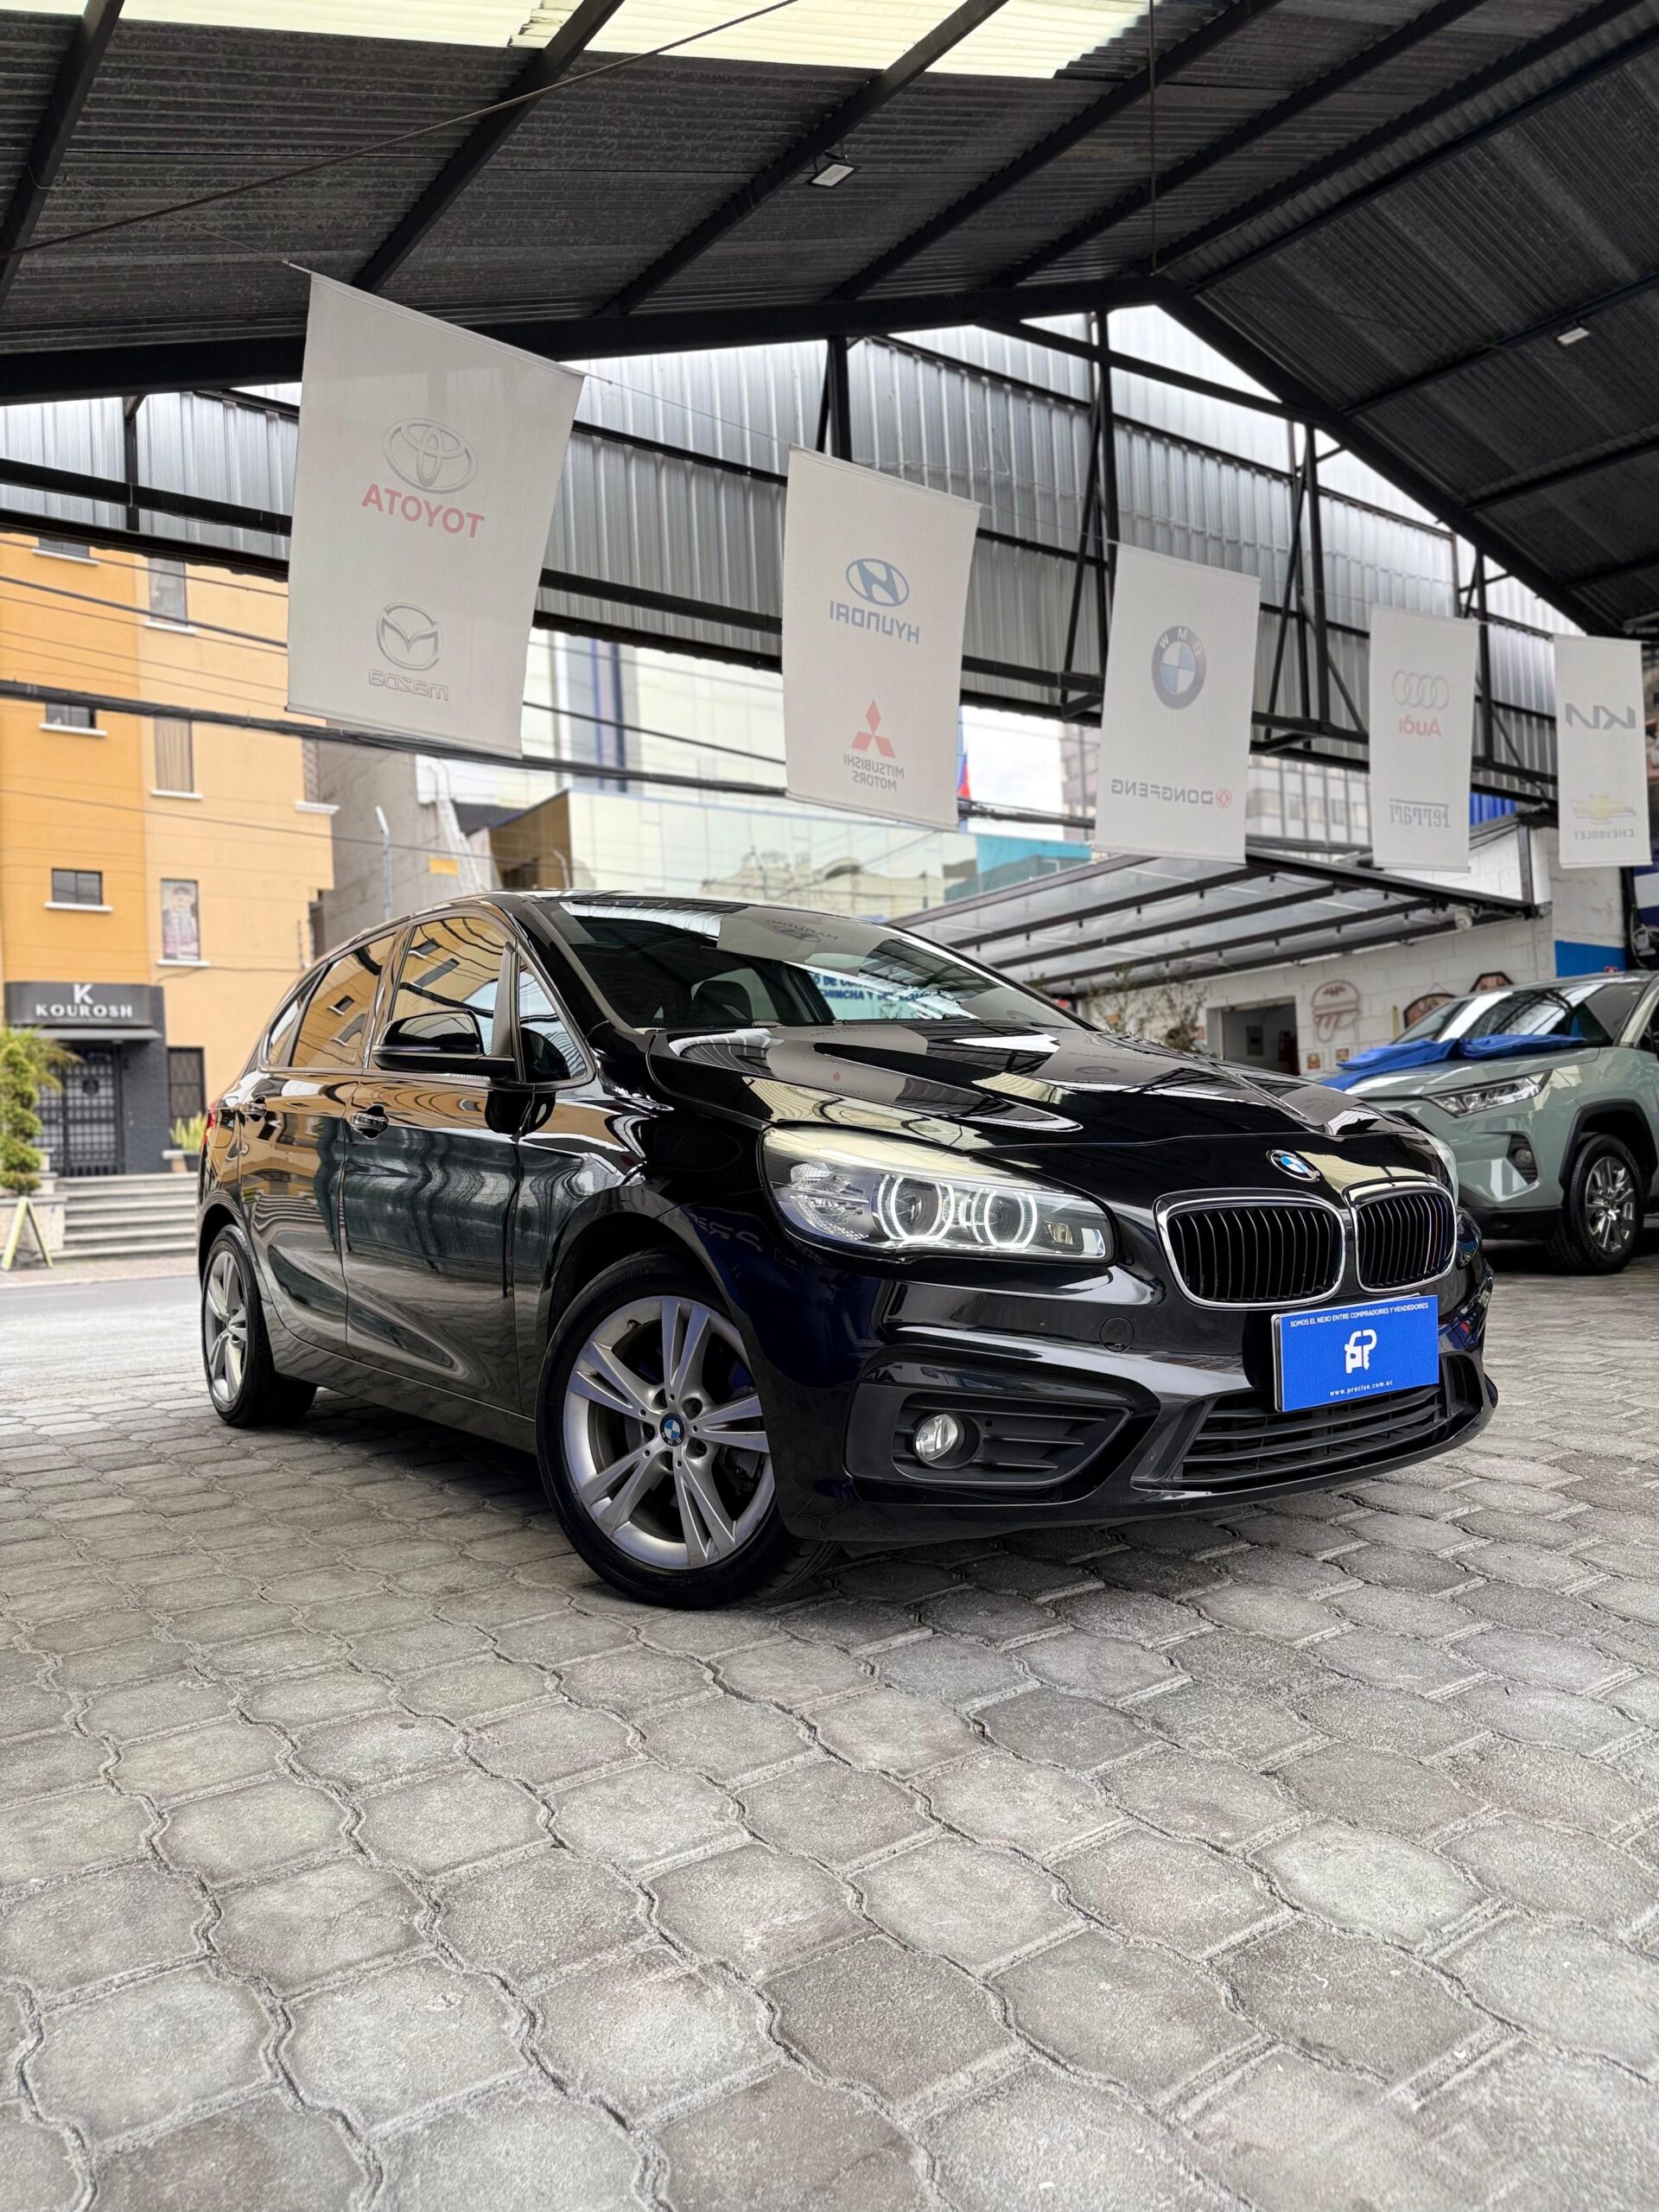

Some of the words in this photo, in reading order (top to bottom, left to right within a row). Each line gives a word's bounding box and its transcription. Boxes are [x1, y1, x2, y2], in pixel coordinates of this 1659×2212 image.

[73, 983, 94, 1005] K
[35, 1003, 133, 1018] KOUROSH
[1289, 1318, 1310, 1328] SOMOS
[1310, 1317, 1317, 1325] EL
[1317, 1315, 1332, 1324] NEXO
[1332, 1313, 1350, 1322] ENTRE
[1350, 1308, 1389, 1319] COMPRADORES
[1394, 1302, 1429, 1313] VENDEDORES
[1329, 1379, 1394, 1397] www.preciso.com.ec
